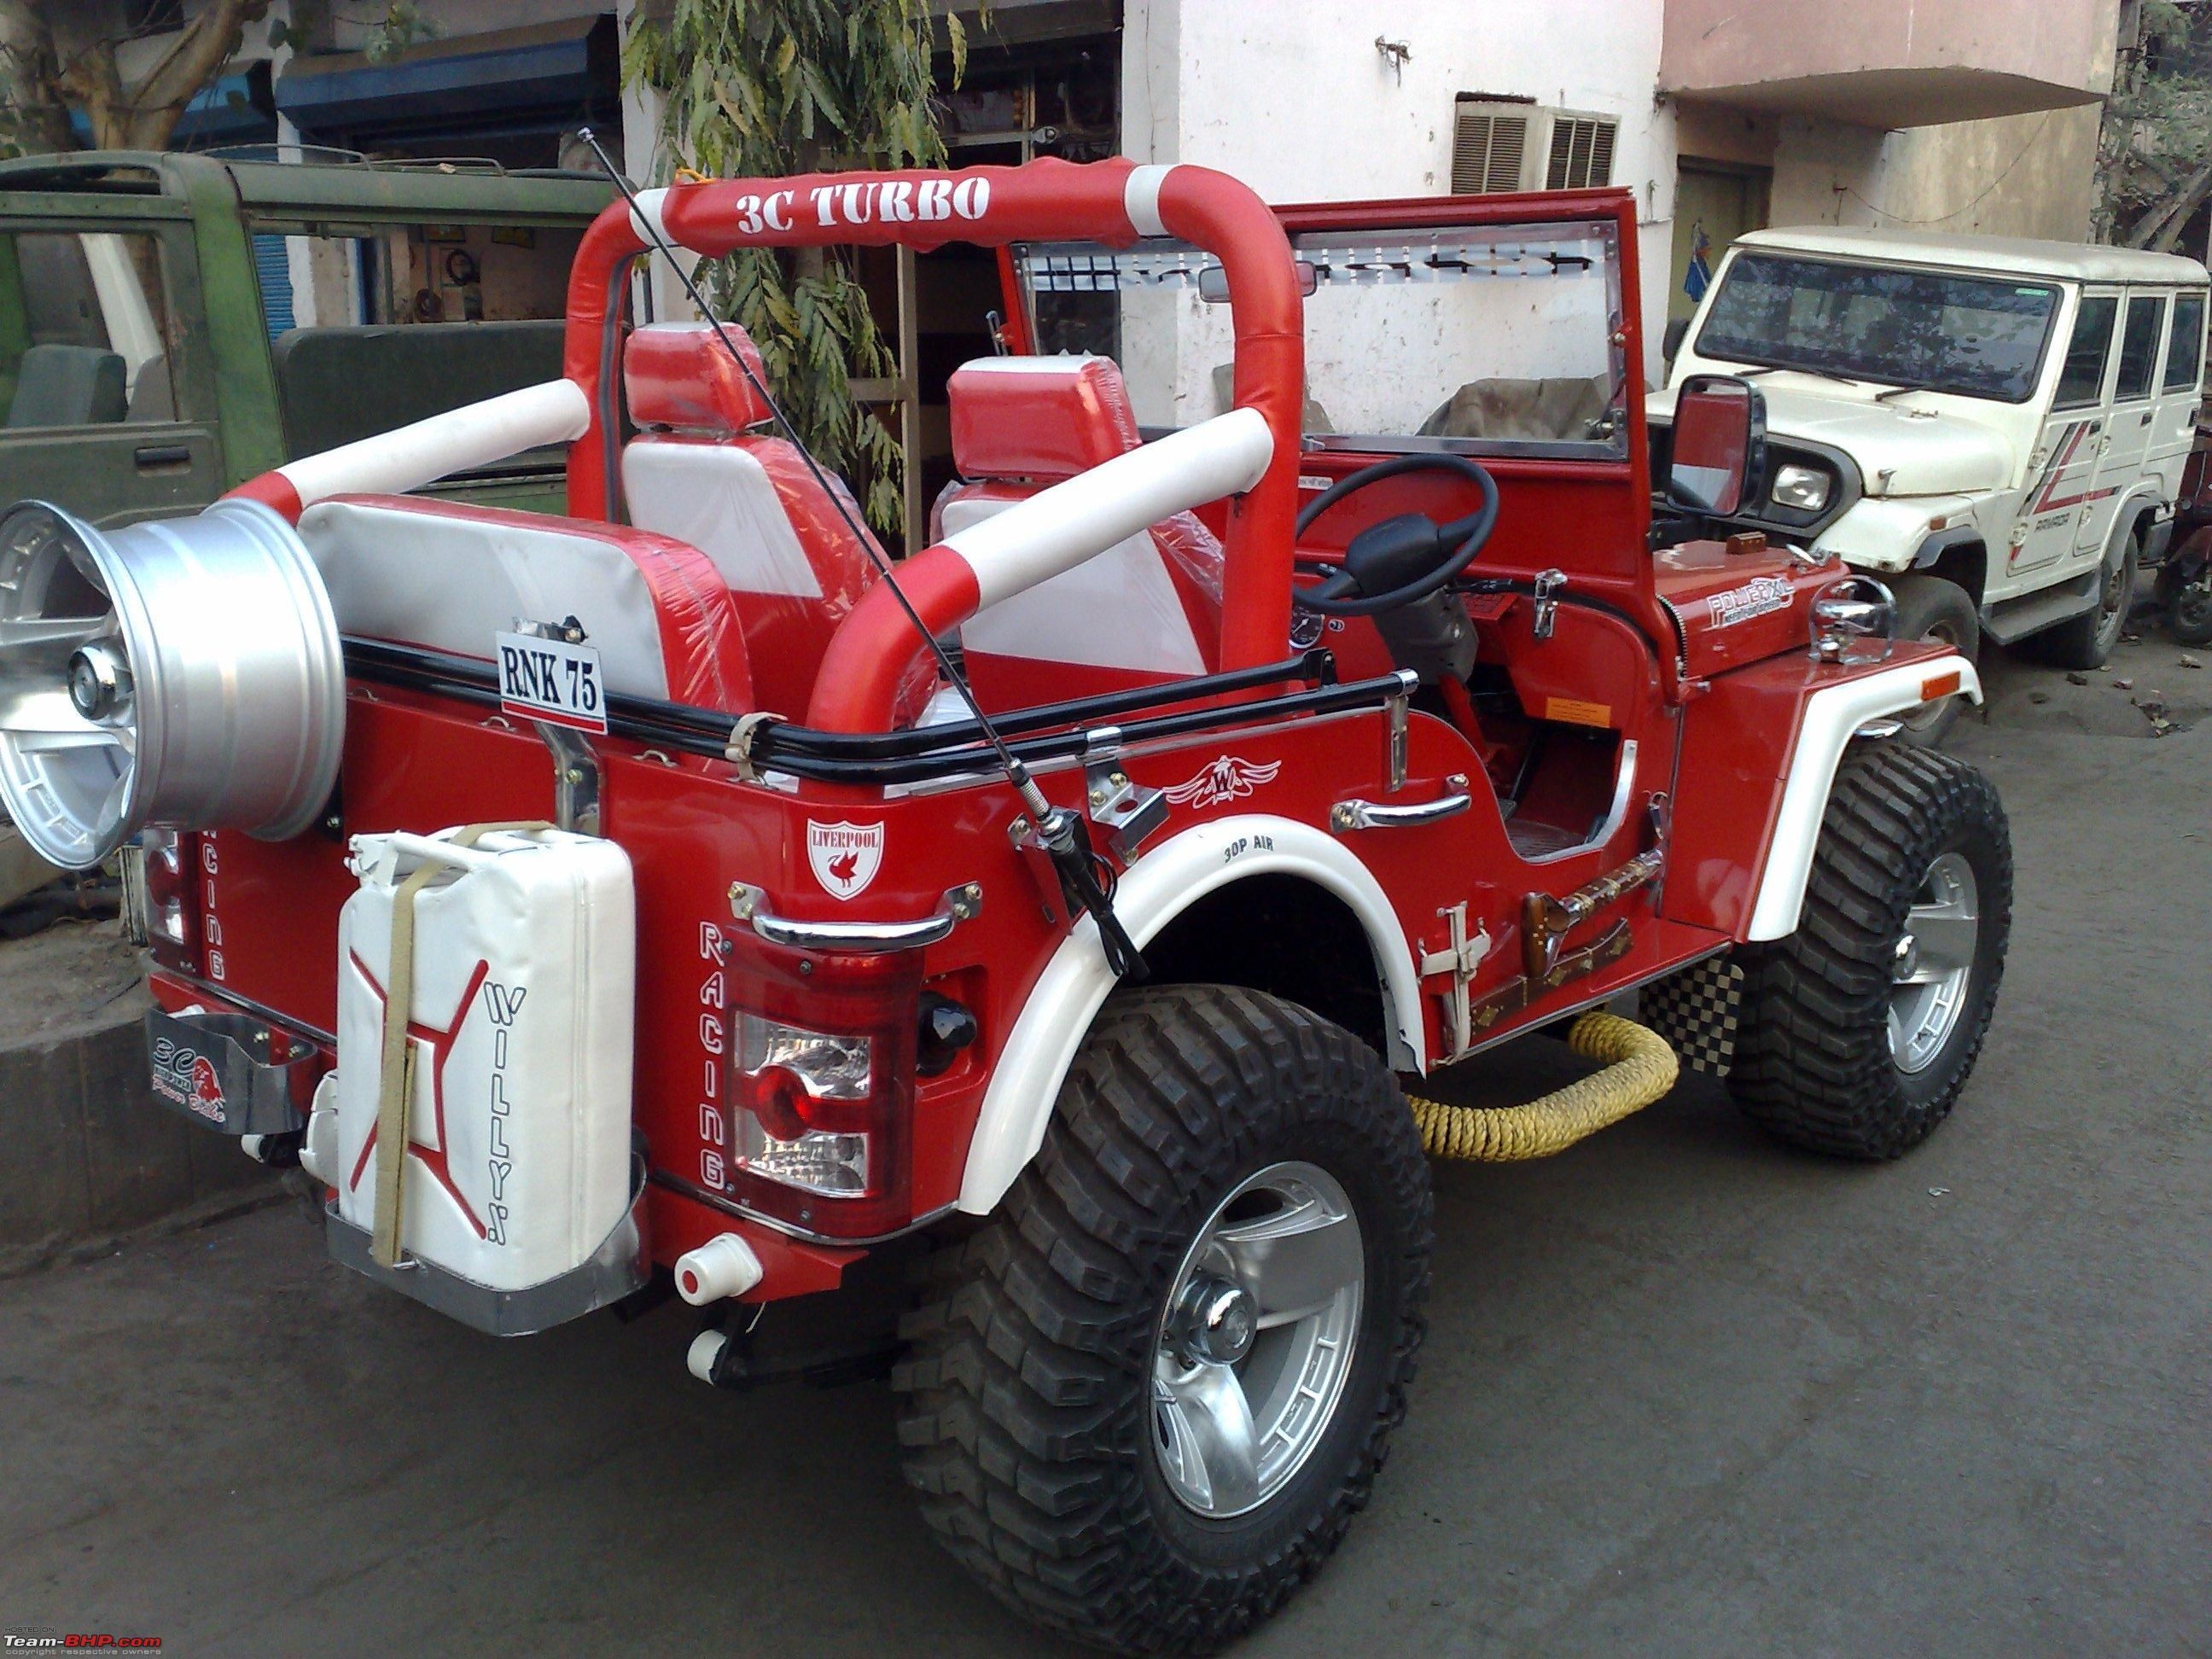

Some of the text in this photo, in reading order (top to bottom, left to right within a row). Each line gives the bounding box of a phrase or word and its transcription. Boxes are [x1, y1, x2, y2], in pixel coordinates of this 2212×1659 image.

[736, 176, 992, 235] 3C TURBO
[501, 645, 597, 712] RNK 75
[812, 830, 878, 848] LIVERPOOL
[1253, 835, 1274, 852] AIR
[153, 1037, 196, 1077] 3C
[699, 921, 725, 1190] RACING
[482, 981, 527, 1246] WILLYS
